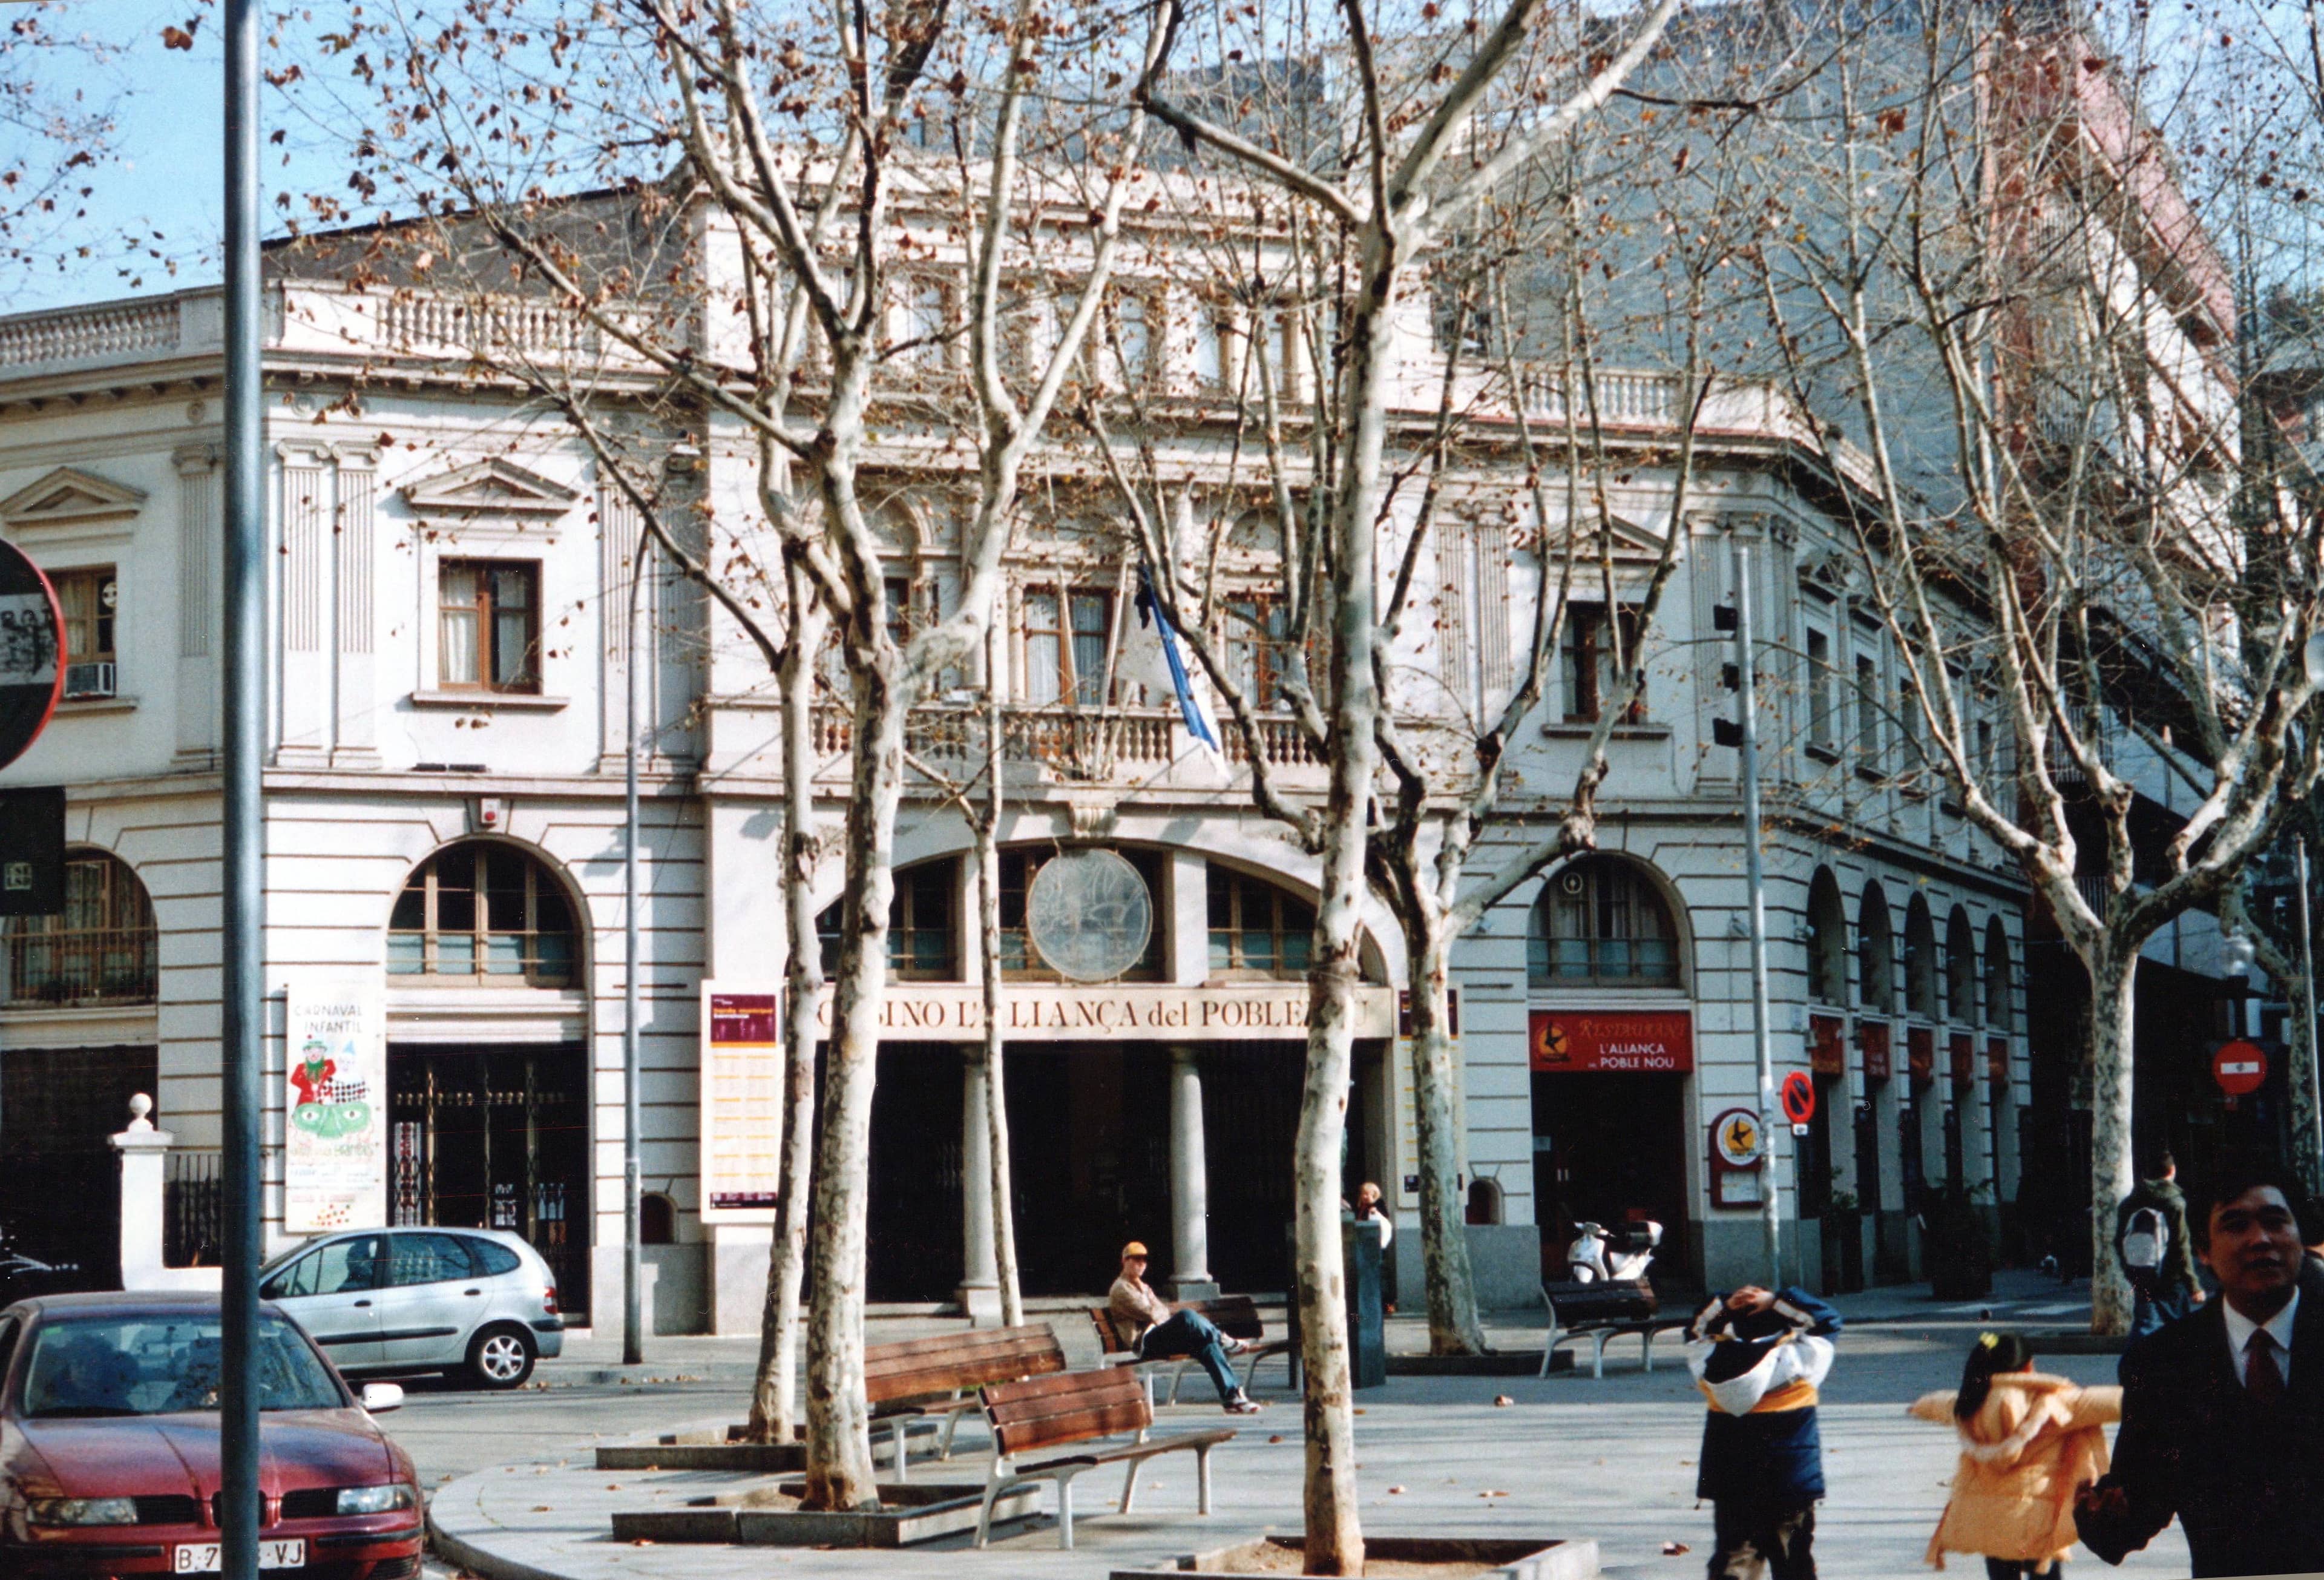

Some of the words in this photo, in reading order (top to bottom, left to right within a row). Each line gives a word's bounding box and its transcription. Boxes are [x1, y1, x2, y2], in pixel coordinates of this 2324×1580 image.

[294, 1004, 363, 1017] CARNAVAL
[957, 1000, 1137, 1034] L'LIANÇA
[1147, 1000, 1189, 1028] del
[304, 1021, 363, 1034] INFANTIL
[1600, 1042, 1666, 1056] L'ALIANÇA
[1600, 1056, 1640, 1069] POBLE
[1644, 1056, 1675, 1069] NOU
